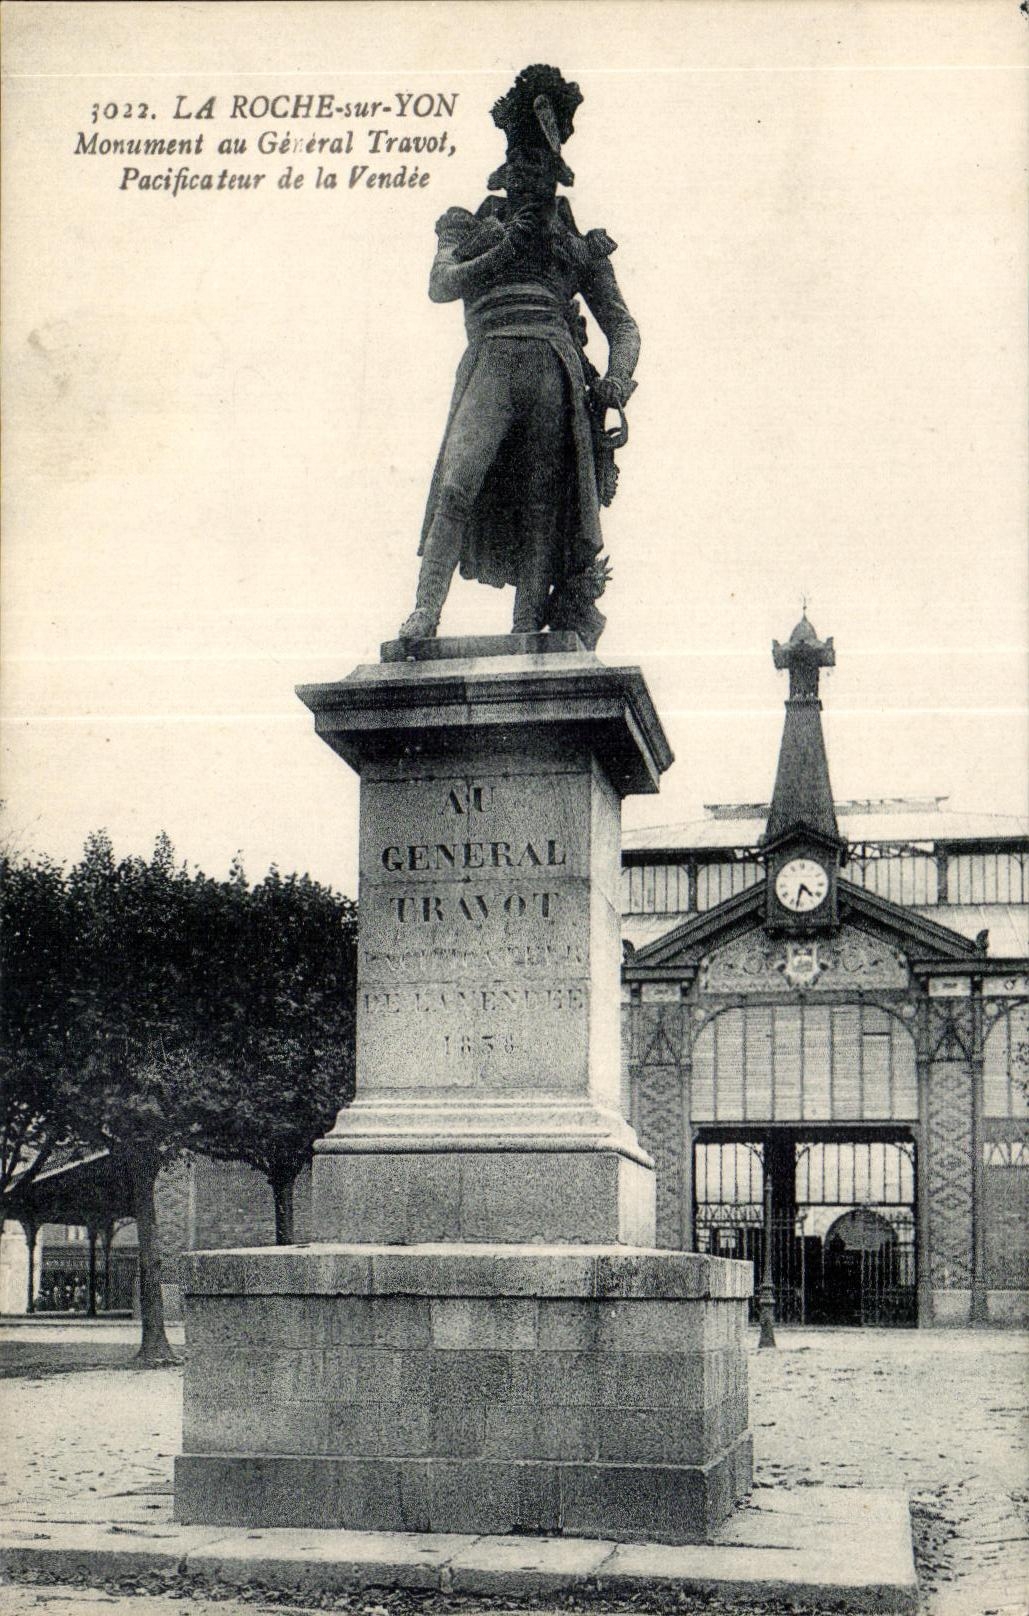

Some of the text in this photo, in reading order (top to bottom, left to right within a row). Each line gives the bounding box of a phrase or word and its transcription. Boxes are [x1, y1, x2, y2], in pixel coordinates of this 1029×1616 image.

[438, 786, 495, 815] AU
[381, 839, 567, 872] GENERAL
[389, 892, 560, 923] TRAVOT
